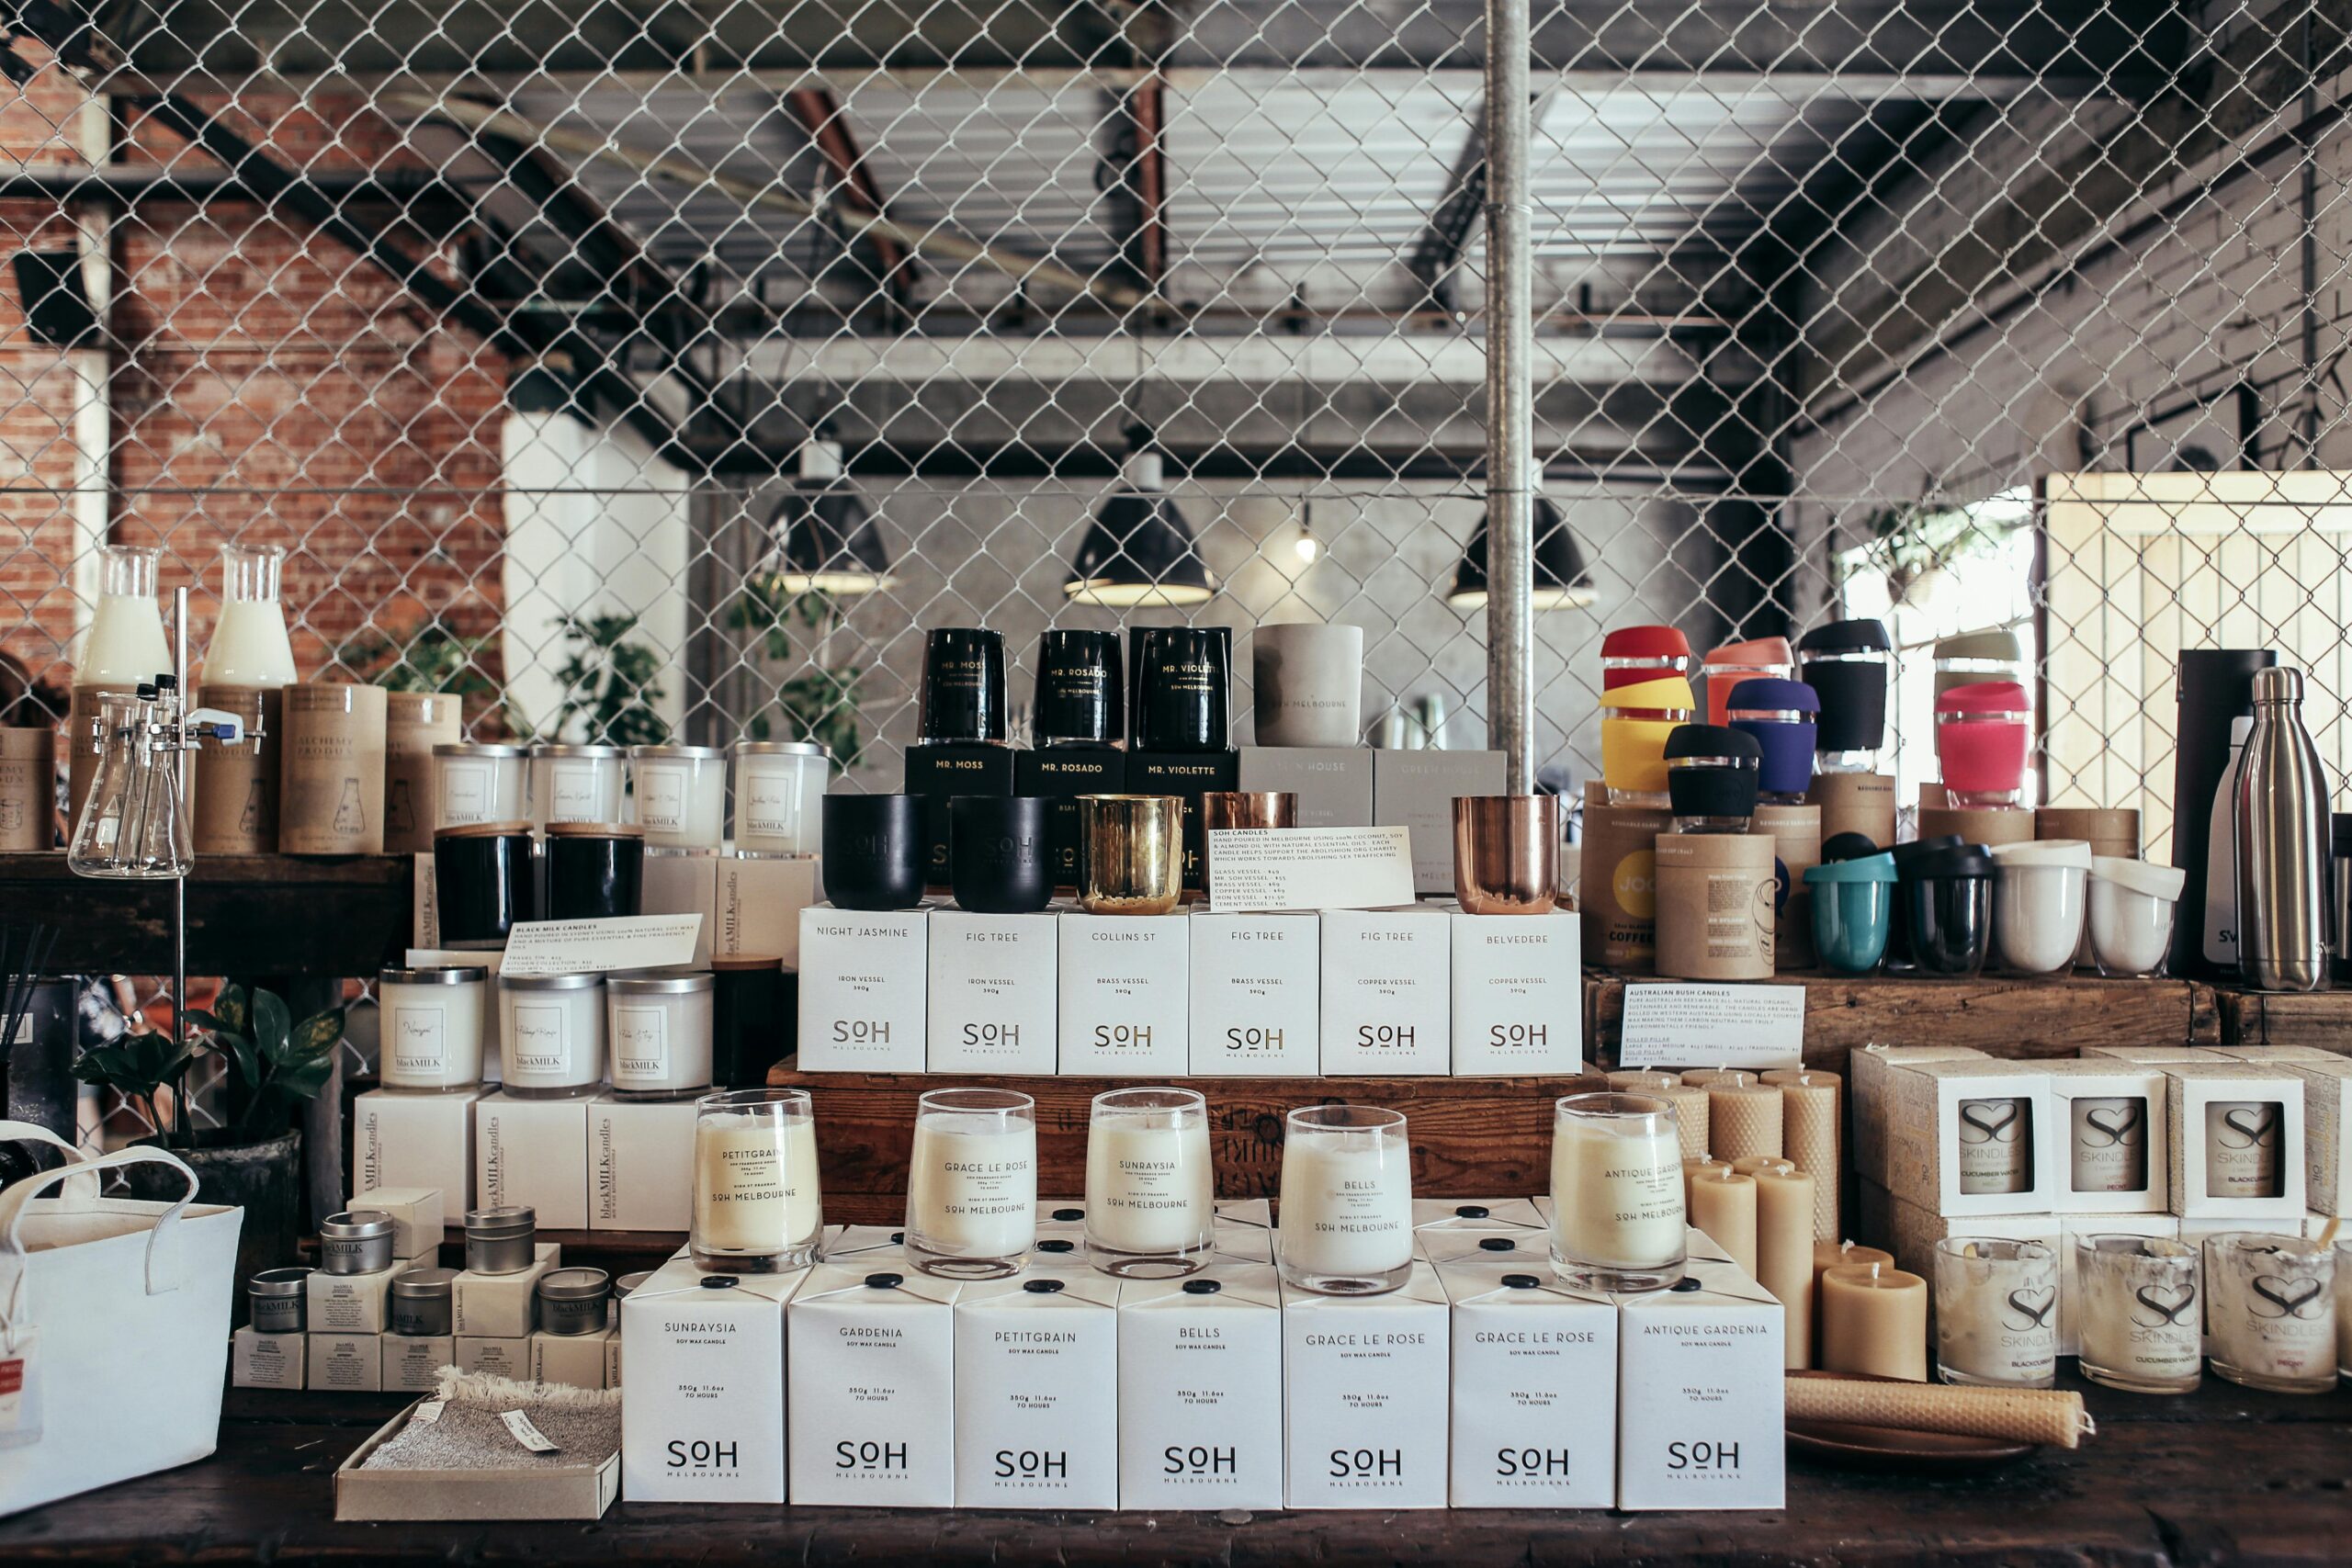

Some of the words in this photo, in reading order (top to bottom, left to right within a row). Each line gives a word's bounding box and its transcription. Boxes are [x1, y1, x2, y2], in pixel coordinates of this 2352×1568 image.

[1069, 669, 1107, 678] ROSADO
[1162, 665, 1177, 673] MR.
[956, 761, 983, 769] MOSS
[1062, 763, 1102, 773] ROSADO
[1168, 766, 1215, 774] VIOLETTE
[1308, 762, 1345, 772] HOUSE
[1620, 876, 1655, 894] JOC
[817, 927, 853, 936] NIGHT
[857, 928, 908, 937] JASMINE
[1091, 932, 1139, 941] COLLINS
[1231, 931, 1250, 940] FIG
[1256, 931, 1283, 941] TREE
[1362, 932, 1380, 941] FIG
[1385, 932, 1413, 941] TREE
[967, 933, 985, 942] FIG
[990, 933, 1018, 942] TREE
[1487, 935, 1547, 944] BELVEDERE
[397, 1057, 441, 1067] blackMILK
[516, 1057, 560, 1066] blackMILK
[619, 1060, 660, 1070] blackMILK
[722, 1148, 783, 1159] PETITGRAIN
[600, 1118, 610, 1220] blackMILKcandles
[944, 1162, 983, 1172] GRACE
[989, 1164, 1001, 1172] LE
[1005, 1161, 1027, 1171] ROSE
[1119, 1160, 1175, 1169] SUNRAYSIA
[1604, 1168, 1652, 1178] ANTIQUE
[1344, 1181, 1375, 1190] BELLS
[735, 1189, 796, 1201] MELBOURNE
[970, 1203, 1024, 1214] MELBOURNE
[1128, 1200, 1187, 1209] MELBOURNE
[1642, 1206, 1684, 1220] MELBOURN
[1340, 1222, 1398, 1233] MELBOURNE
[665, 1323, 736, 1333] SUNRAYSIA
[840, 1327, 902, 1337] GARDENIA
[1180, 1328, 1220, 1337] BELLS
[1644, 1325, 1698, 1336] ANTIQUE
[1703, 1325, 1767, 1335] GARDENIA
[995, 1332, 1076, 1342] PETITGRAIN
[1306, 1335, 1356, 1346] GRACE
[1363, 1335, 1379, 1345] LE
[1387, 1334, 1424, 1344] ROSE
[1476, 1332, 1525, 1343] GRACE
[1533, 1333, 1549, 1343] LE
[1556, 1332, 1594, 1343] ROSE
